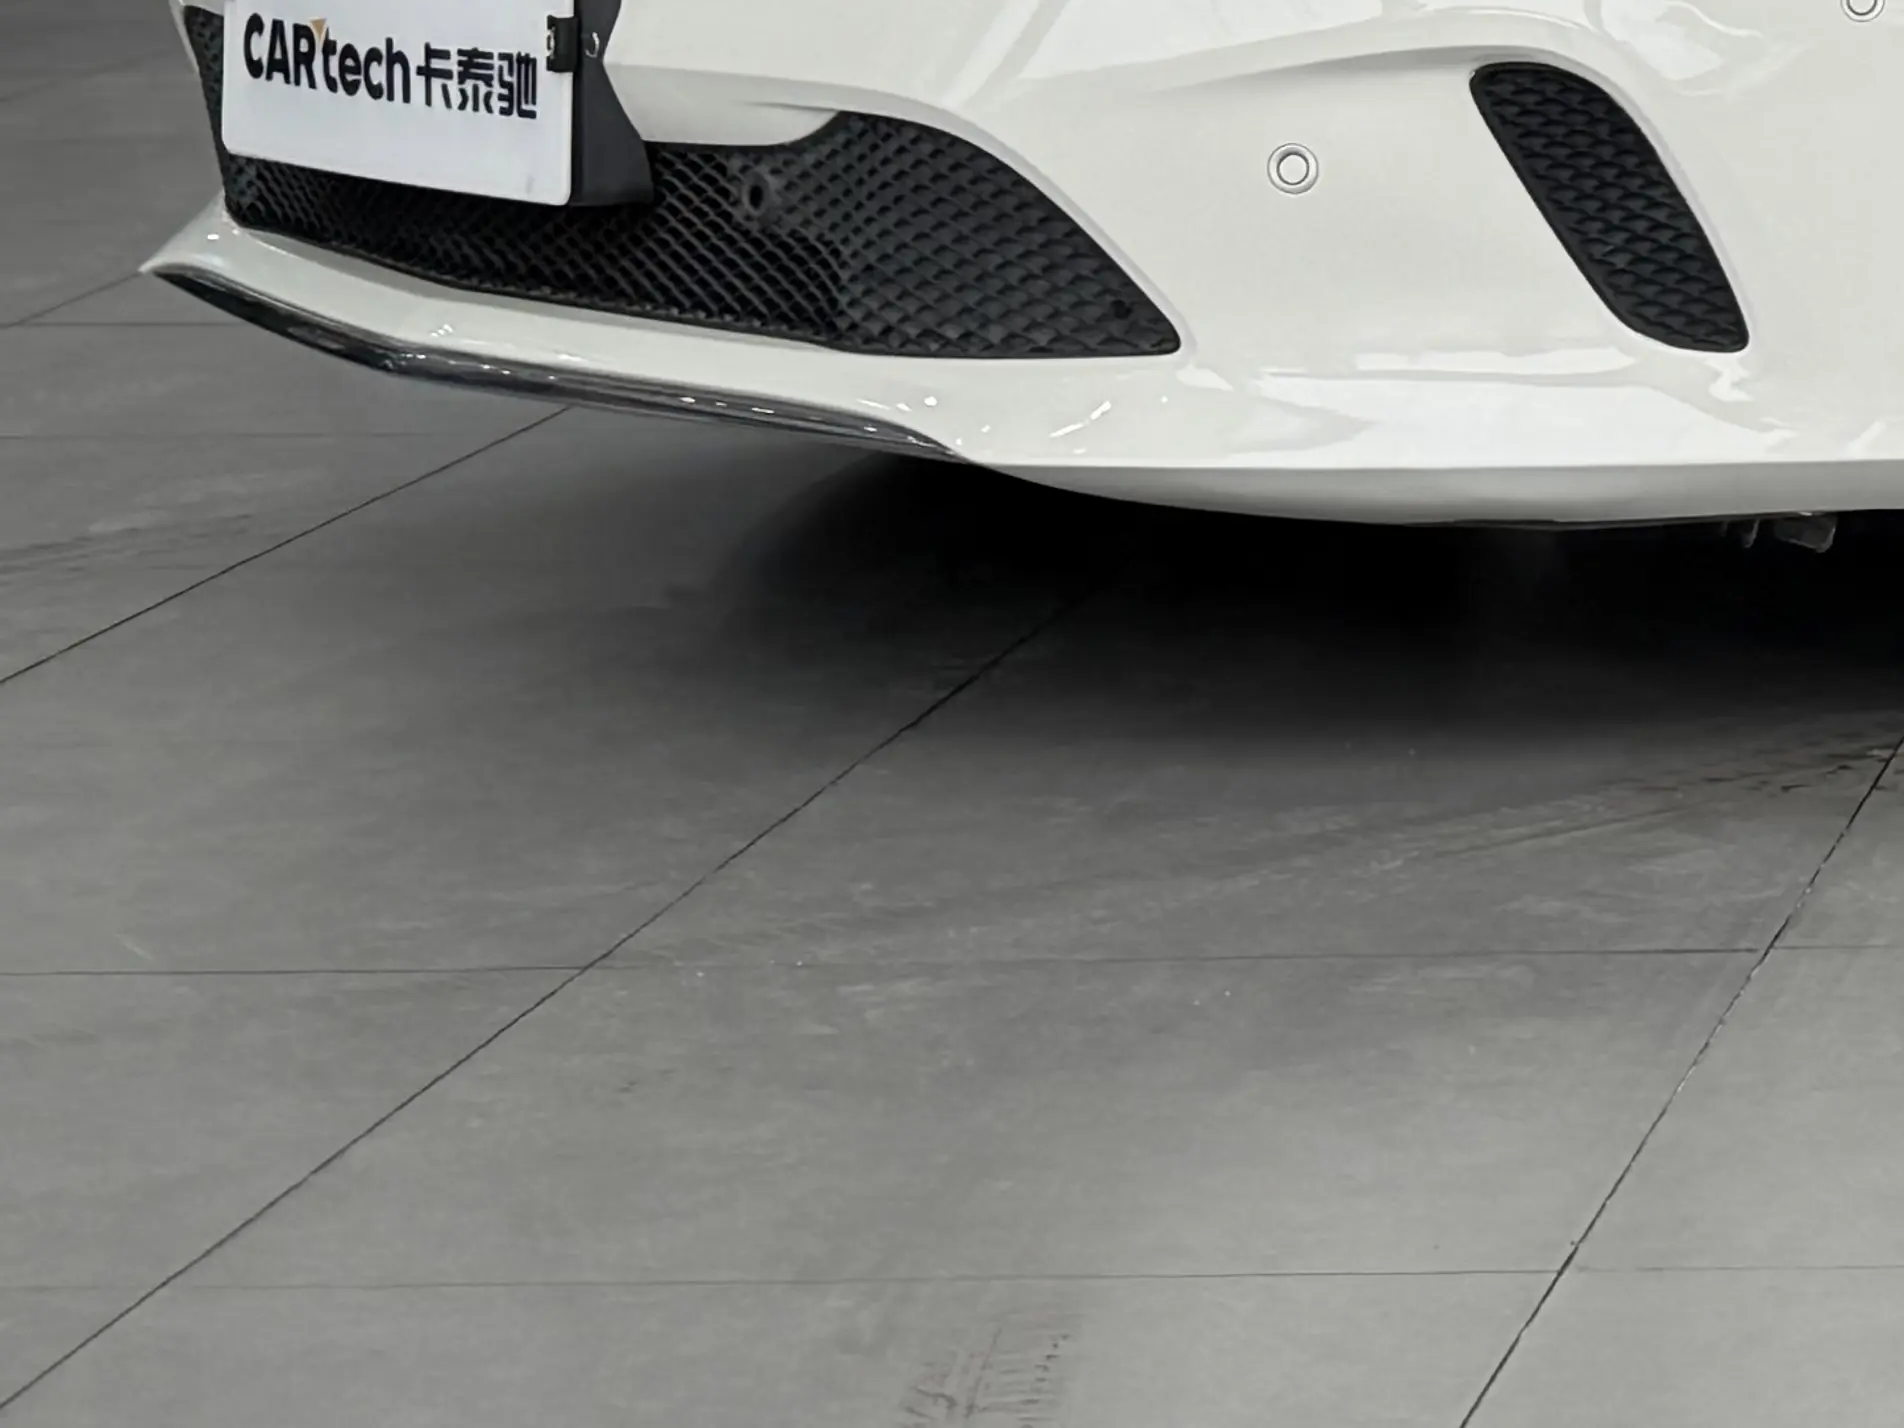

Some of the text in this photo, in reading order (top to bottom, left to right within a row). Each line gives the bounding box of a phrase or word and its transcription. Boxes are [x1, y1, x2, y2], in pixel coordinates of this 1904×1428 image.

[242, 11, 538, 120] CARtech 卡泰驰
